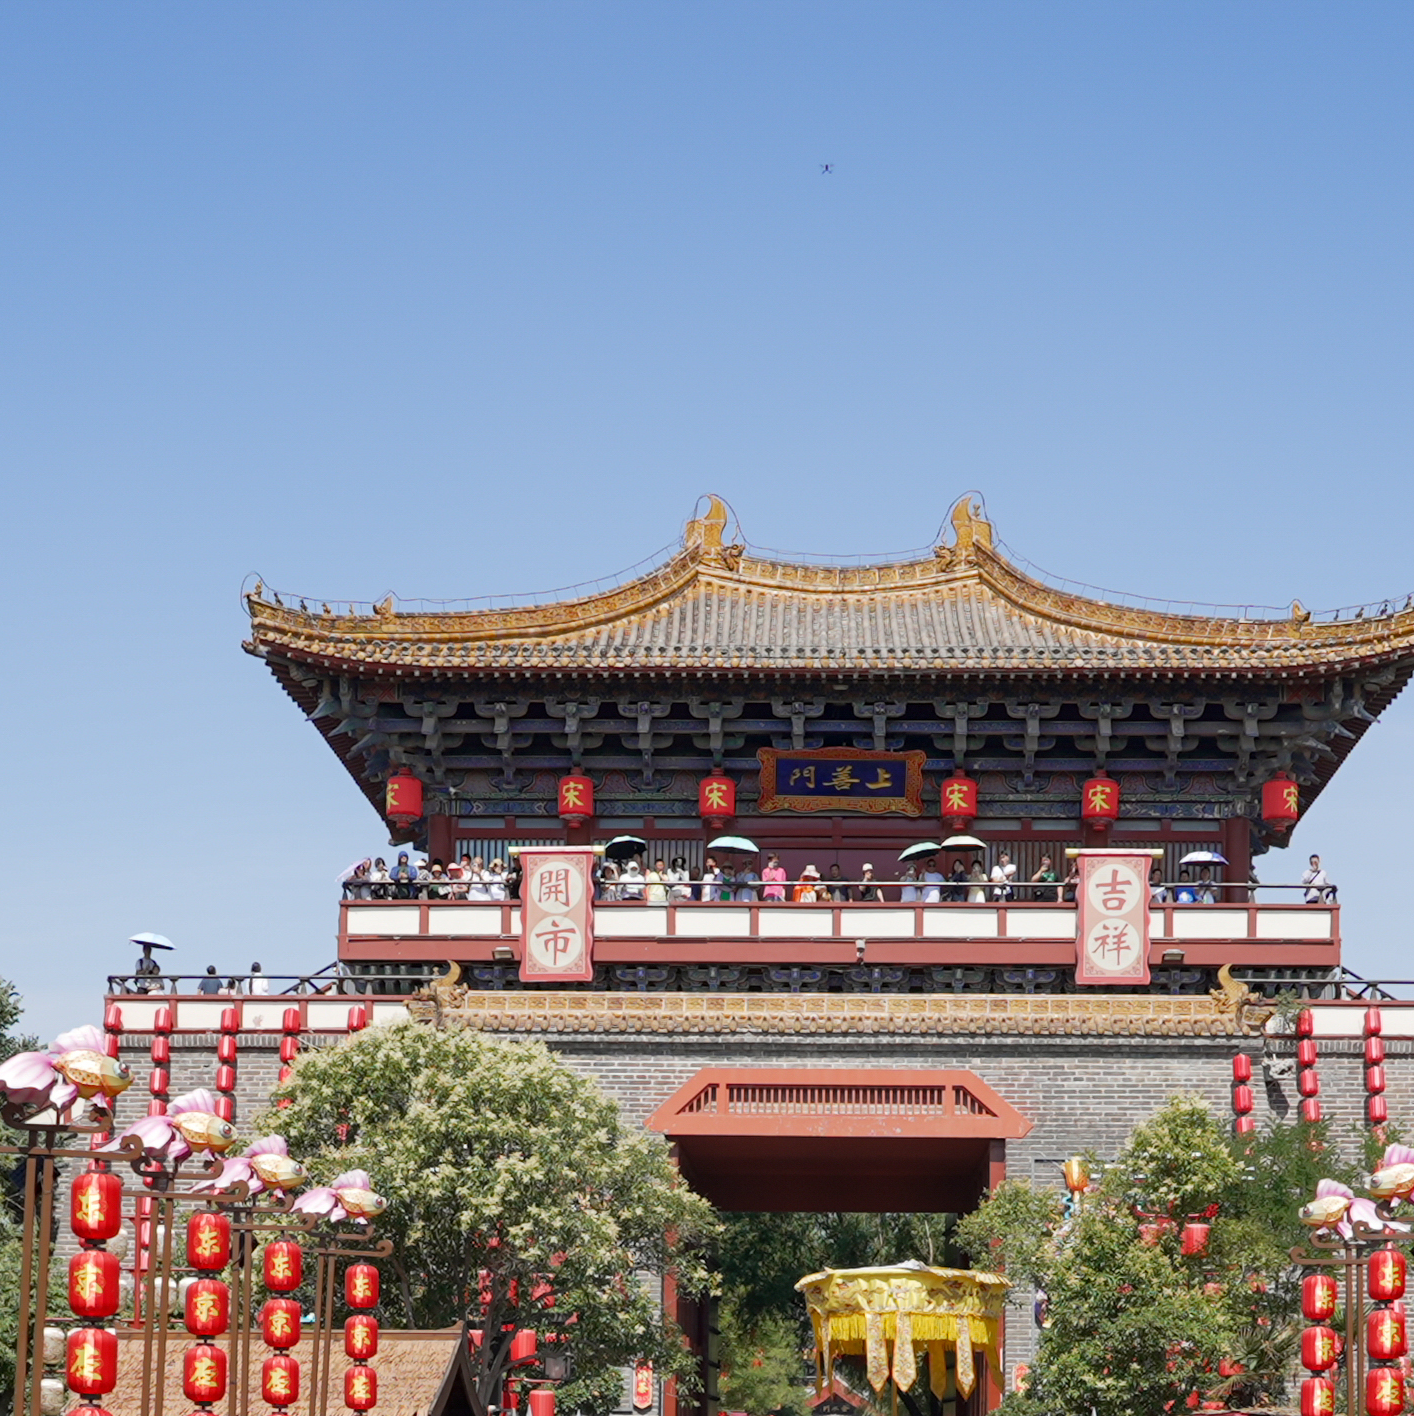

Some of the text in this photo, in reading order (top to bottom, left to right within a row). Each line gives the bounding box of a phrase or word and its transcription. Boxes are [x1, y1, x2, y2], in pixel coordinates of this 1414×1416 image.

[789, 765, 893, 791] 上善門
[565, 782, 582, 807] 宋
[707, 783, 726, 808] 宋
[949, 784, 967, 809] 宋
[1089, 785, 1111, 812] 宋
[534, 869, 578, 966] 開市
[1092, 869, 1134, 967] 吉祥
